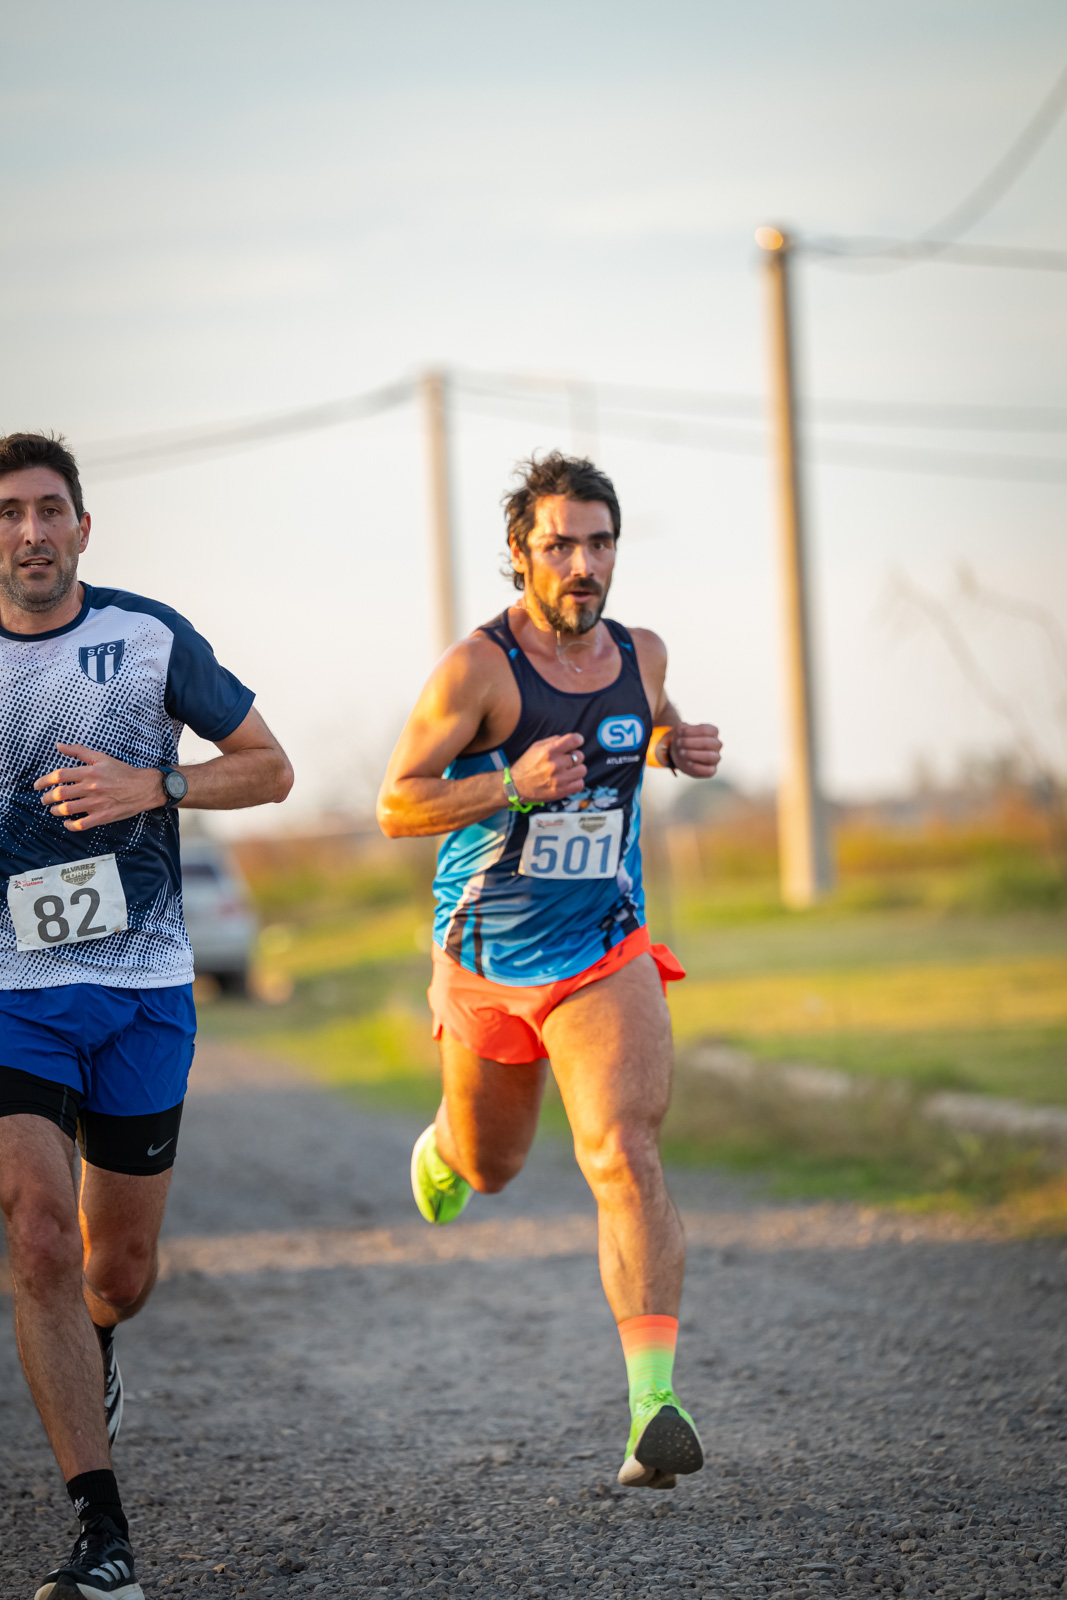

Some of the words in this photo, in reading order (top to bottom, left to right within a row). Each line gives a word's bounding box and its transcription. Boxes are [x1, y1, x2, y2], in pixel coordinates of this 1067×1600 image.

[87, 644, 116, 657] SFC
[609, 723, 637, 745] SM
[530, 834, 612, 875] 501
[61, 863, 96, 877] ALVAREZ
[63, 868, 95, 880] CORRE
[34, 888, 107, 943] 82
